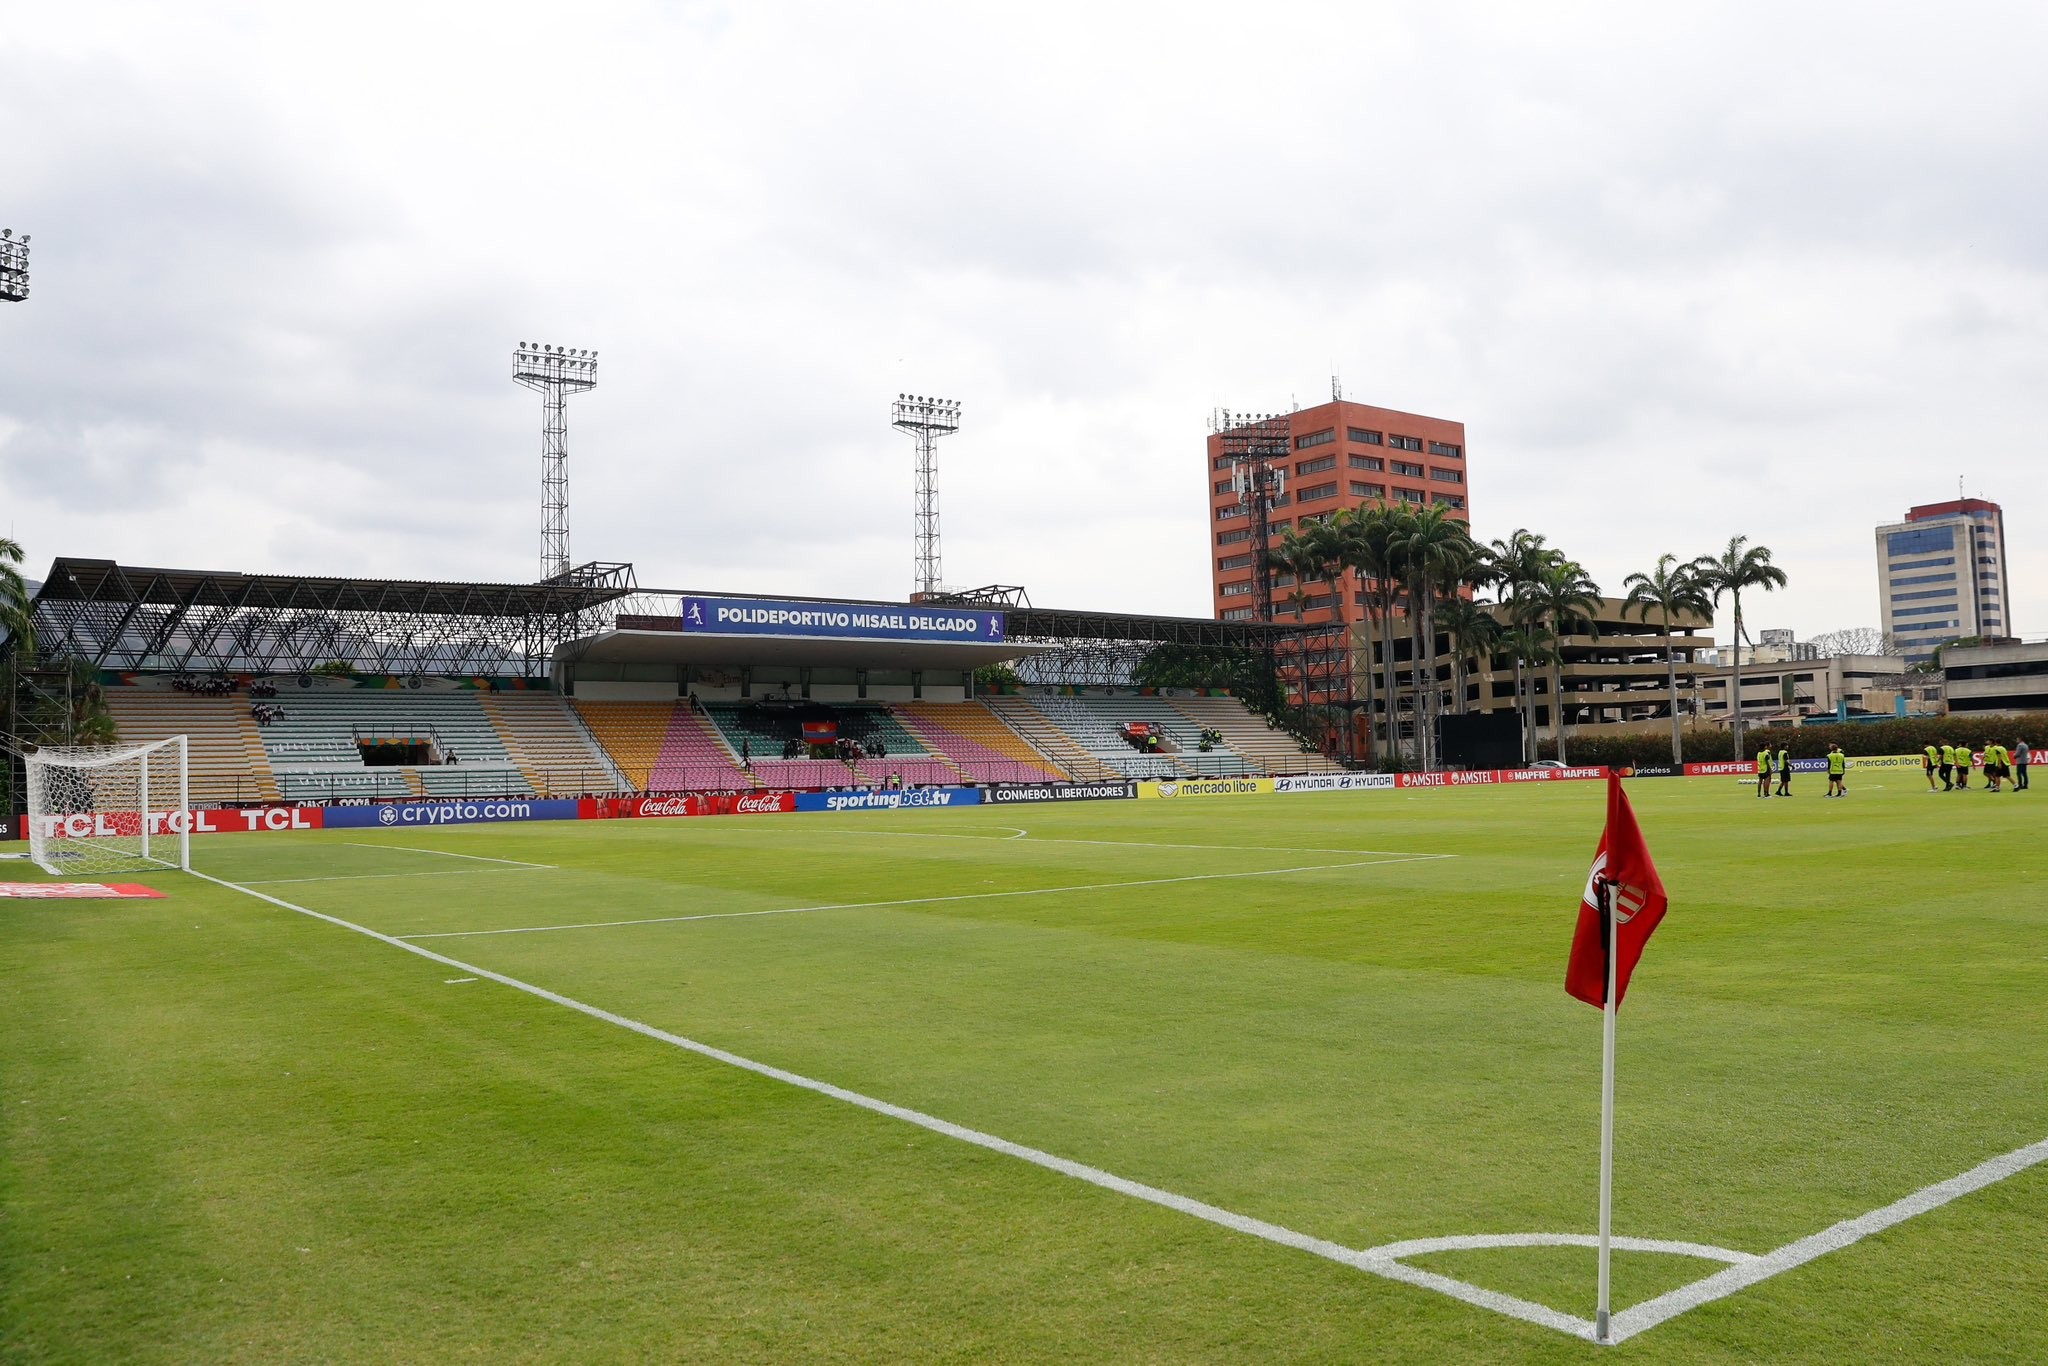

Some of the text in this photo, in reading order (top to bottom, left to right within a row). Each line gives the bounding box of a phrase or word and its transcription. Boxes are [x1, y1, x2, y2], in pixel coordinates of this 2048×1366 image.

[718, 607, 977, 632] POLIDEPORTIVO MISAEL DELGADO
[1701, 763, 1752, 774] MAPFRE
[1856, 757, 1921, 767] mercado libre
[1514, 768, 1600, 780] MAPFRE MAPFRE
[1635, 766, 1671, 775] priceless
[1295, 776, 1393, 789] HYUNDAI HYUNDAI
[1412, 771, 1492, 786] AMSTEL AMSTEL
[996, 786, 1124, 801] CONMEBOL LIBERTADORES
[1182, 779, 1257, 795] mercado libre
[827, 790, 951, 811] sportingbet.tv
[402, 803, 530, 823] crypto.com
[39, 808, 310, 838] TCL TCL TCL
